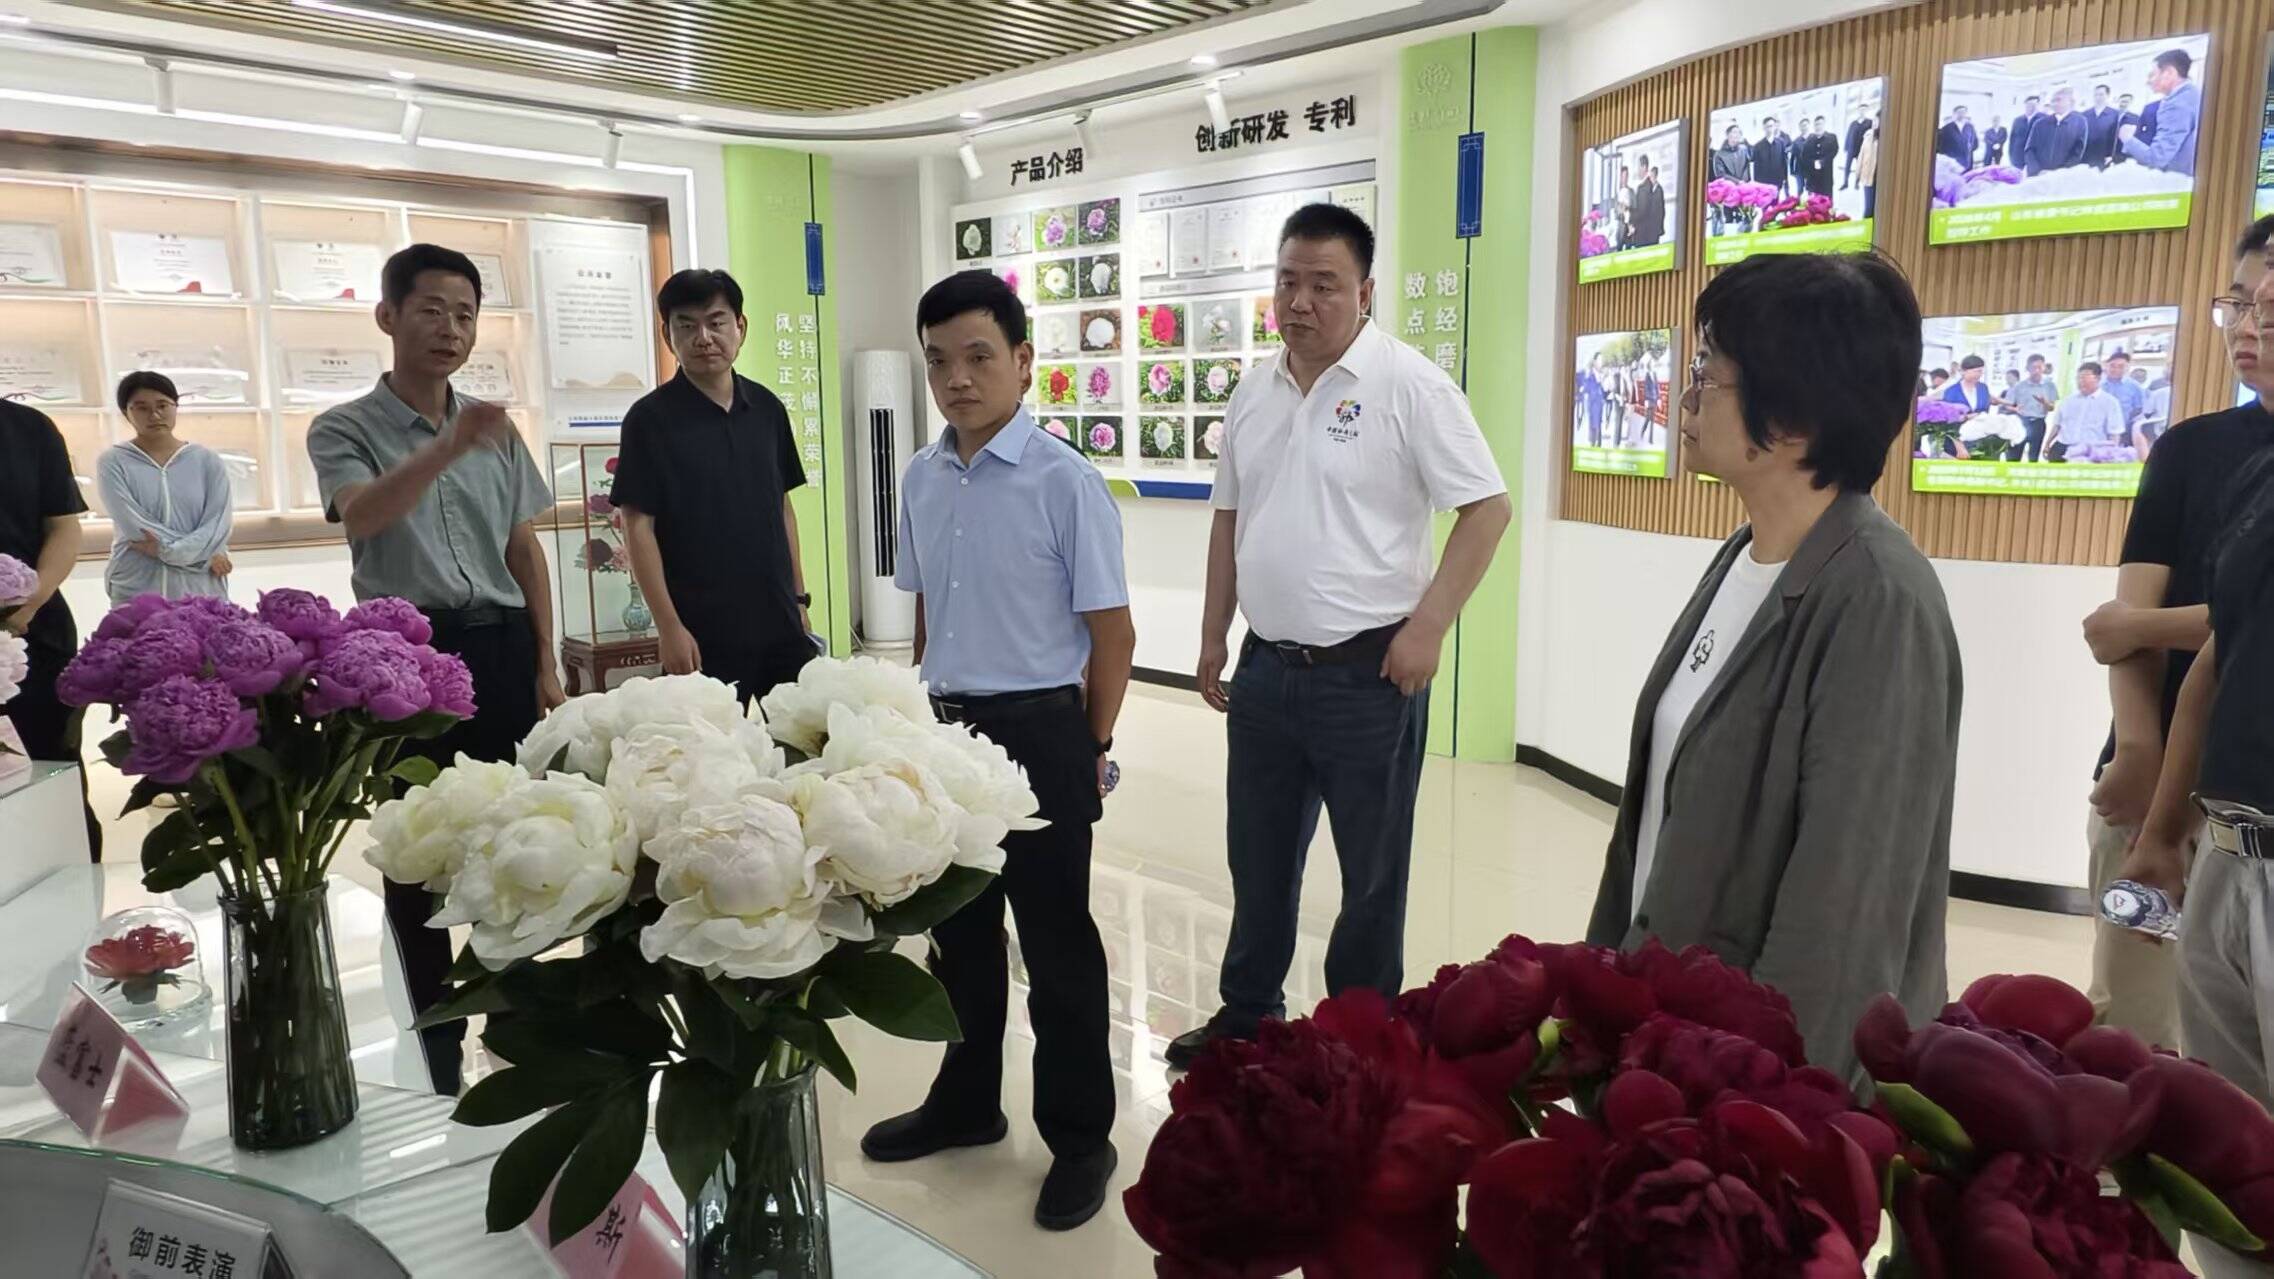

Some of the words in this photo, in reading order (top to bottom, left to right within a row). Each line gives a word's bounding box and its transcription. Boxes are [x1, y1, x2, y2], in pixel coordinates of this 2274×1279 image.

[1196, 110, 1289, 152] 创新研发
[1304, 95, 1356, 133] 专利
[1010, 147, 1083, 187] 产品介绍
[1404, 271, 1427, 354] 数点
[128, 1226, 236, 1279] 御前表演
